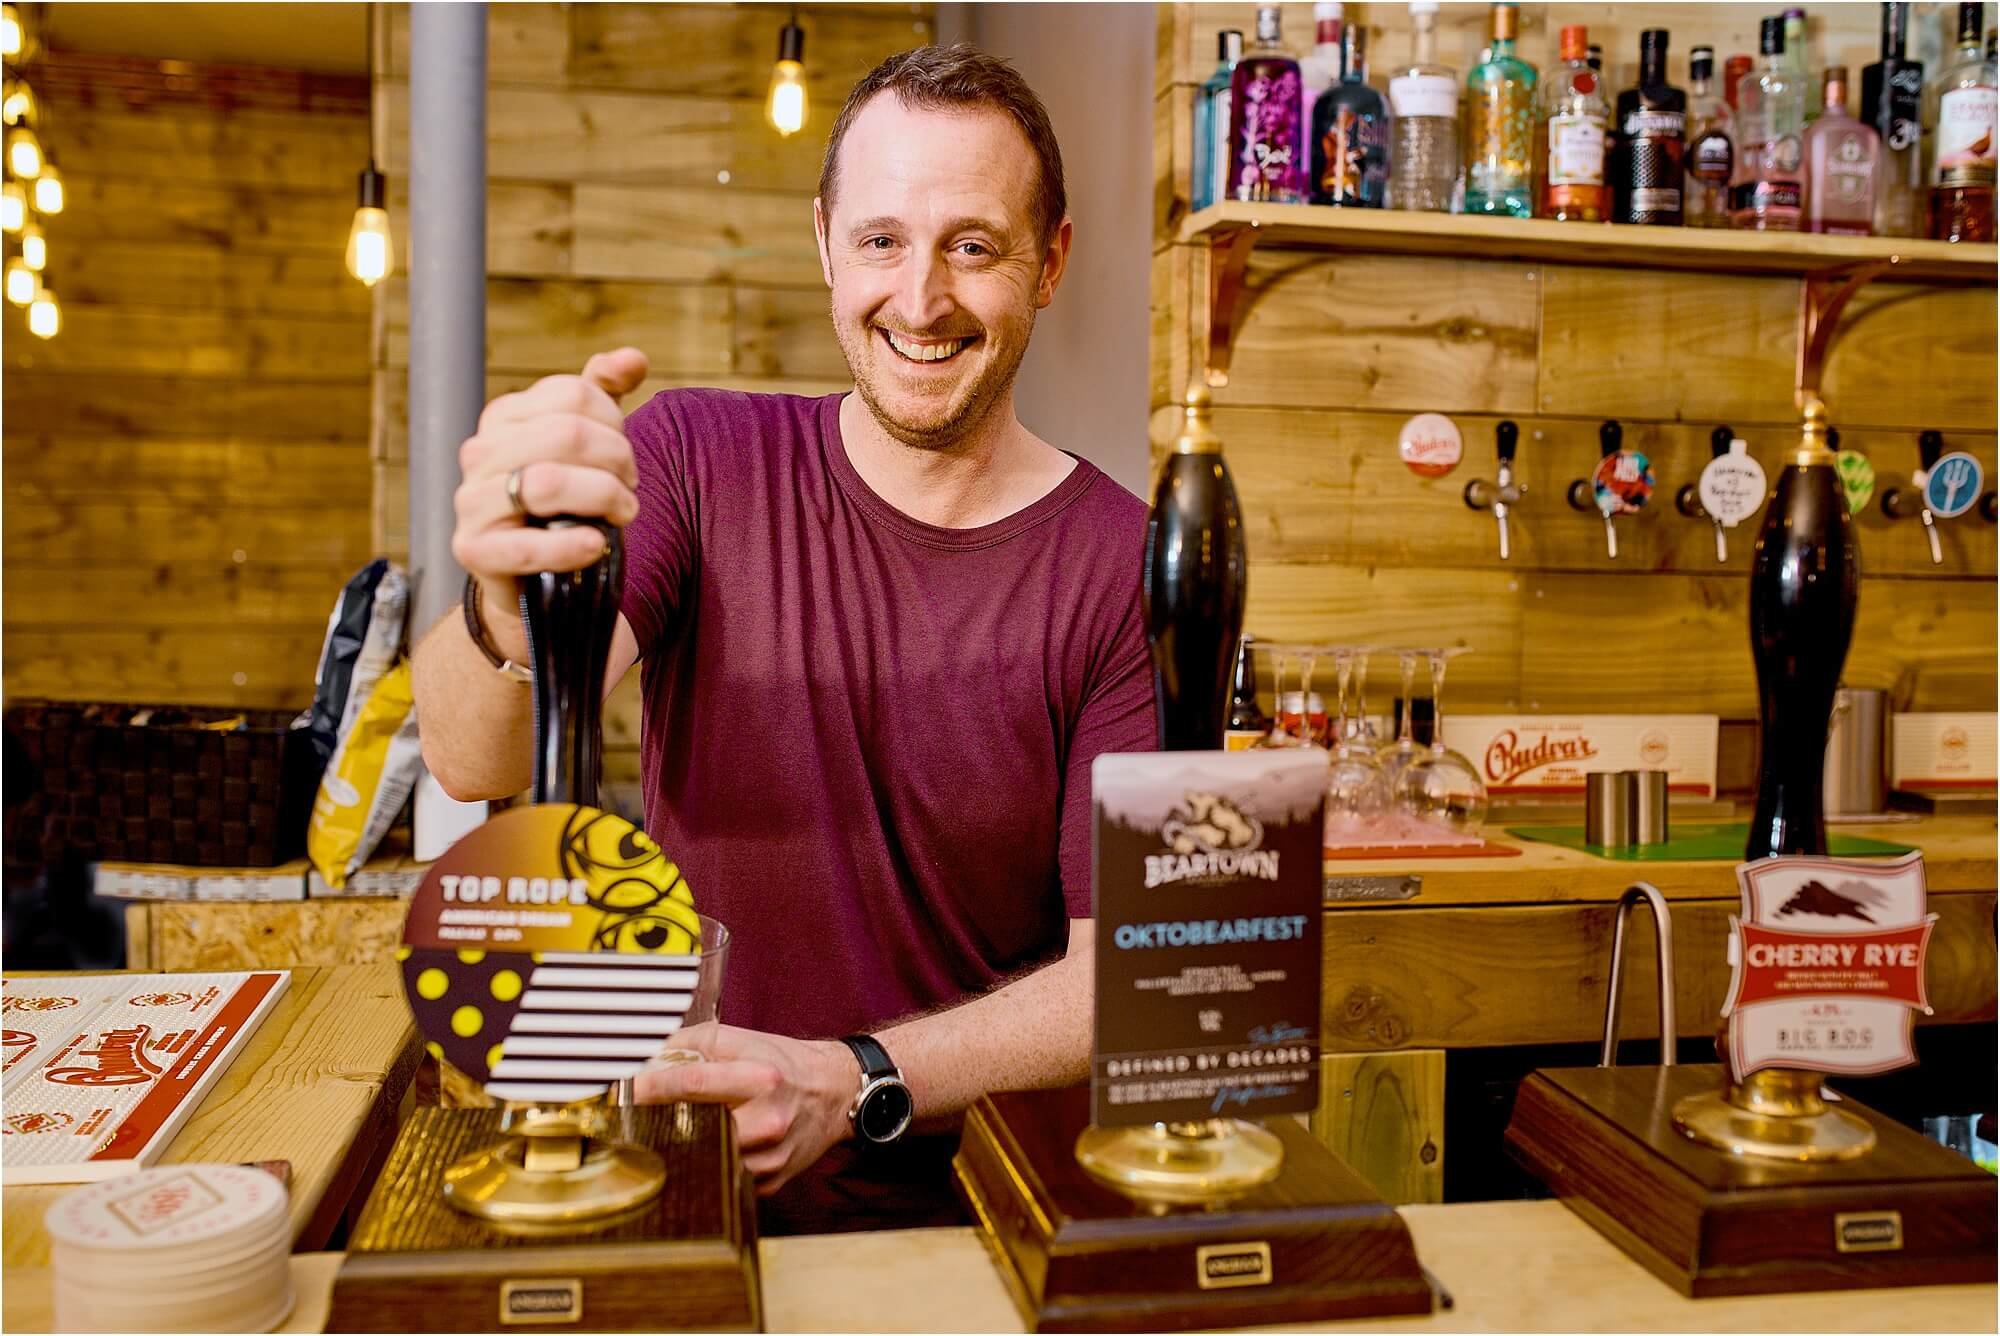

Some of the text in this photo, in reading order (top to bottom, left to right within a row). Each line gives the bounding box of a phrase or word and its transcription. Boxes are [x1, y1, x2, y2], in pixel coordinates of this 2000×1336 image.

[1485, 729, 1598, 784] Budvar
[1144, 851, 1279, 888] BEARTOWN
[440, 876, 588, 904] TOP ROPE
[1114, 915, 1308, 950] OKTOBEARFEST
[1749, 943, 1919, 968] CHERRY RYE
[1777, 1027, 1874, 1044] BIG BOG
[1107, 1046, 1312, 1078] DEFINED BY DECADES
